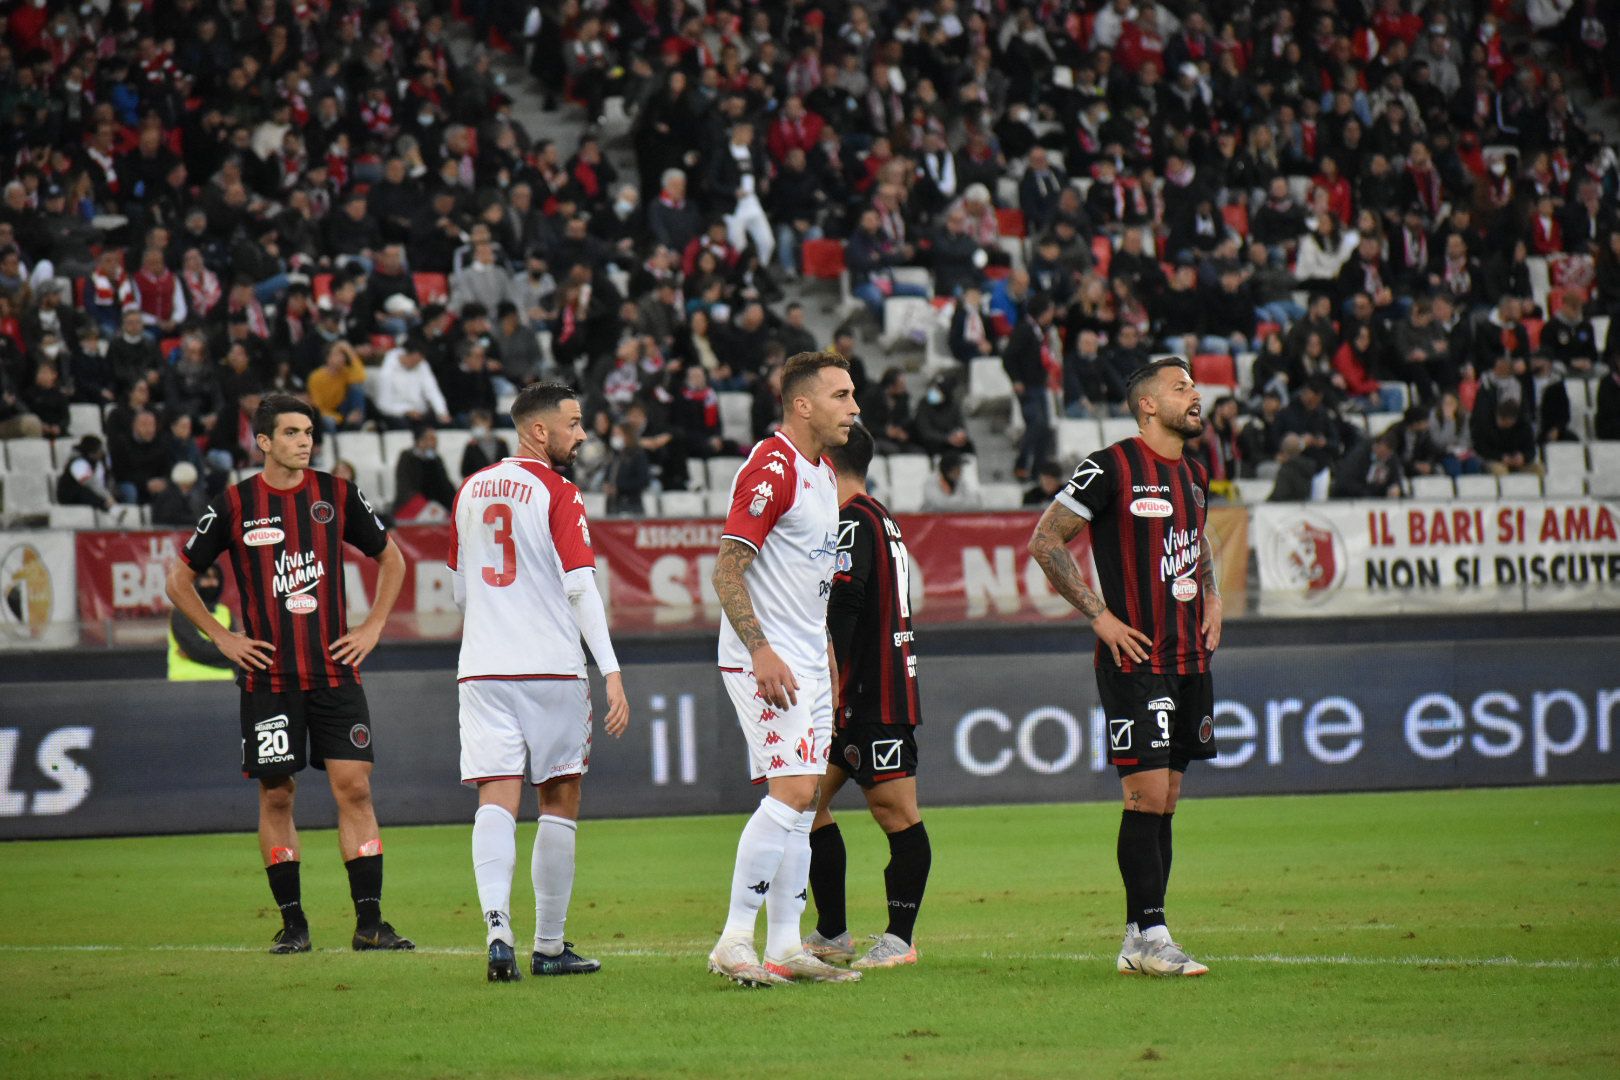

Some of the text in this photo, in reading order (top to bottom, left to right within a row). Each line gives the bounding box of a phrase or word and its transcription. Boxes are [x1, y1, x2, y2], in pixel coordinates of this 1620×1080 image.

[471, 479, 533, 504] GIGLIOTTI
[1132, 485, 1170, 493] GIVOVA
[1136, 501, 1170, 513] Wüber
[243, 516, 282, 528] GIVOVA
[1368, 504, 1618, 547] IL BARI SI AMA
[247, 531, 281, 542] Wüber
[481, 503, 517, 588] 3
[272, 560, 325, 598] MAMMA
[1365, 556, 1441, 591] NON
[1454, 555, 1481, 588] SI
[1157, 710, 1170, 740] 9
[257, 729, 289, 757] 20
[651, 693, 697, 786] il
[257, 753, 295, 765] GIVOVA
